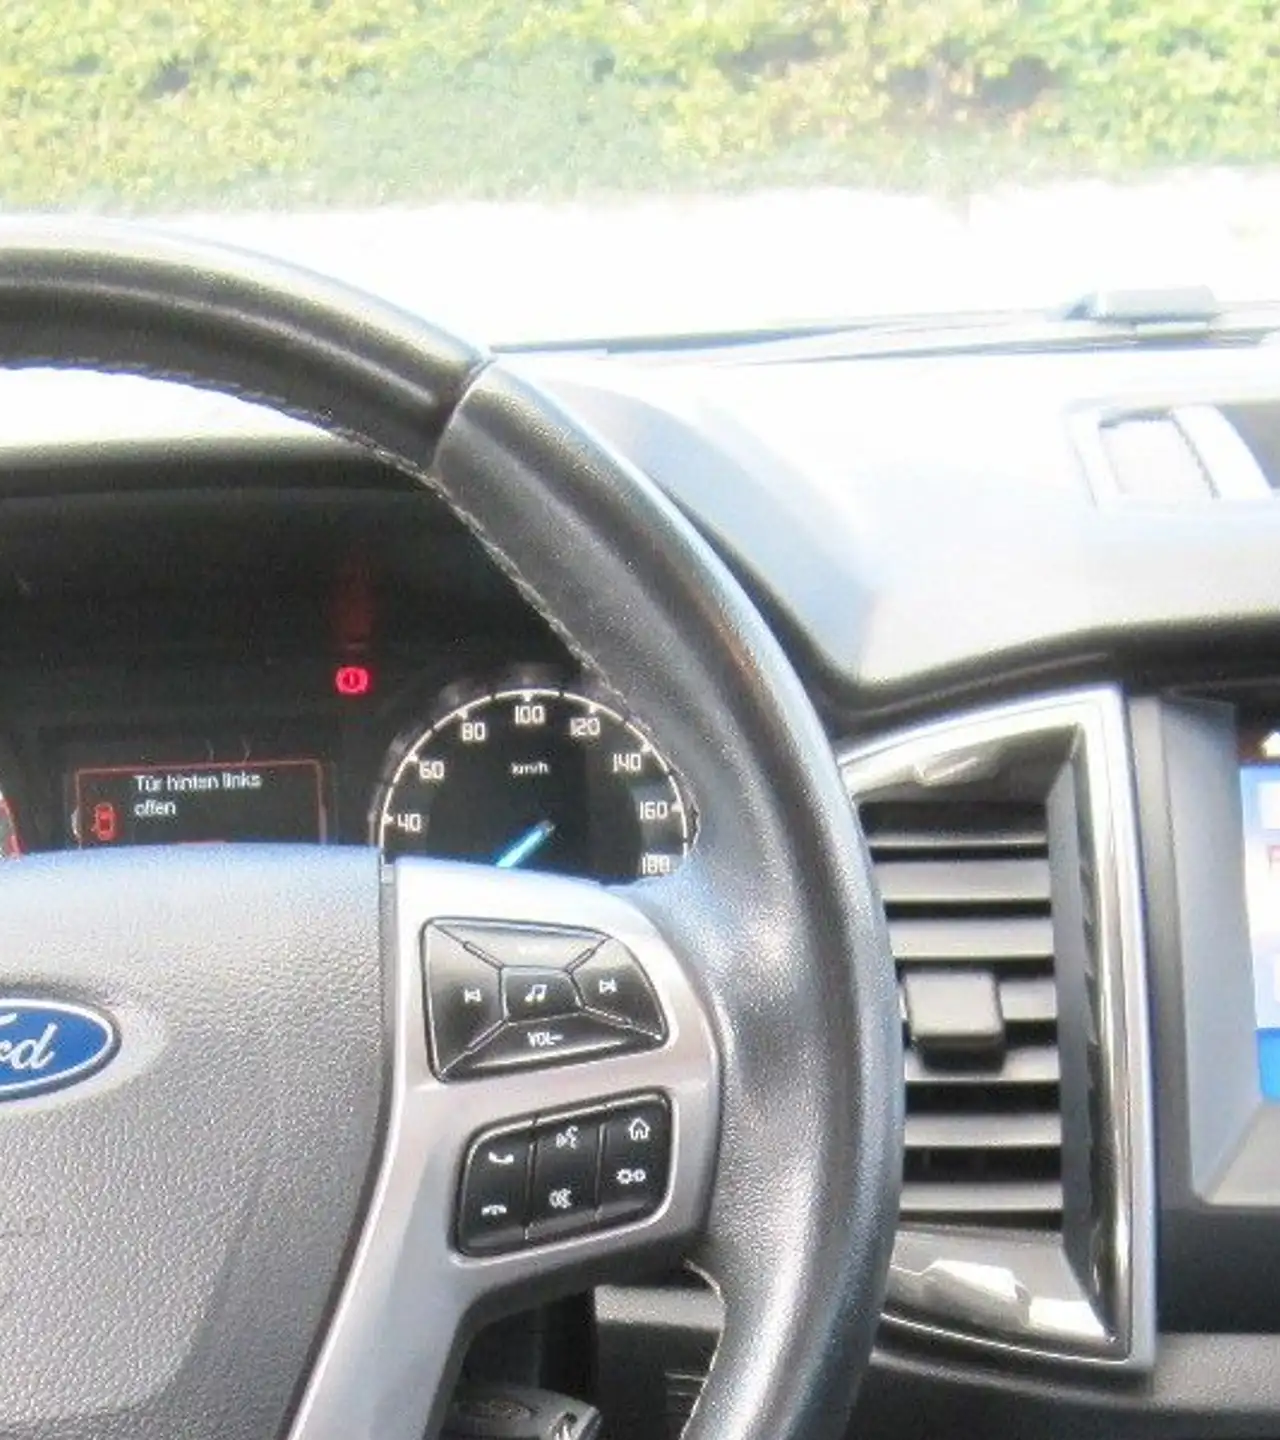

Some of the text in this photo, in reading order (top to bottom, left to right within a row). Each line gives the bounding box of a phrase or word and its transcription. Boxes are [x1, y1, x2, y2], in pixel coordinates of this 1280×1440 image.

[514, 706, 545, 726] 100
[461, 722, 487, 742] 80
[570, 717, 602, 737] 120
[420, 761, 446, 781] 60
[512, 759, 550, 776] km/h
[613, 752, 643, 773] 140
[134, 770, 262, 792] Tür hinten links
[133, 799, 176, 817] offen
[639, 802, 668, 821] 160
[397, 813, 422, 832] 40
[642, 852, 670, 875] 180
